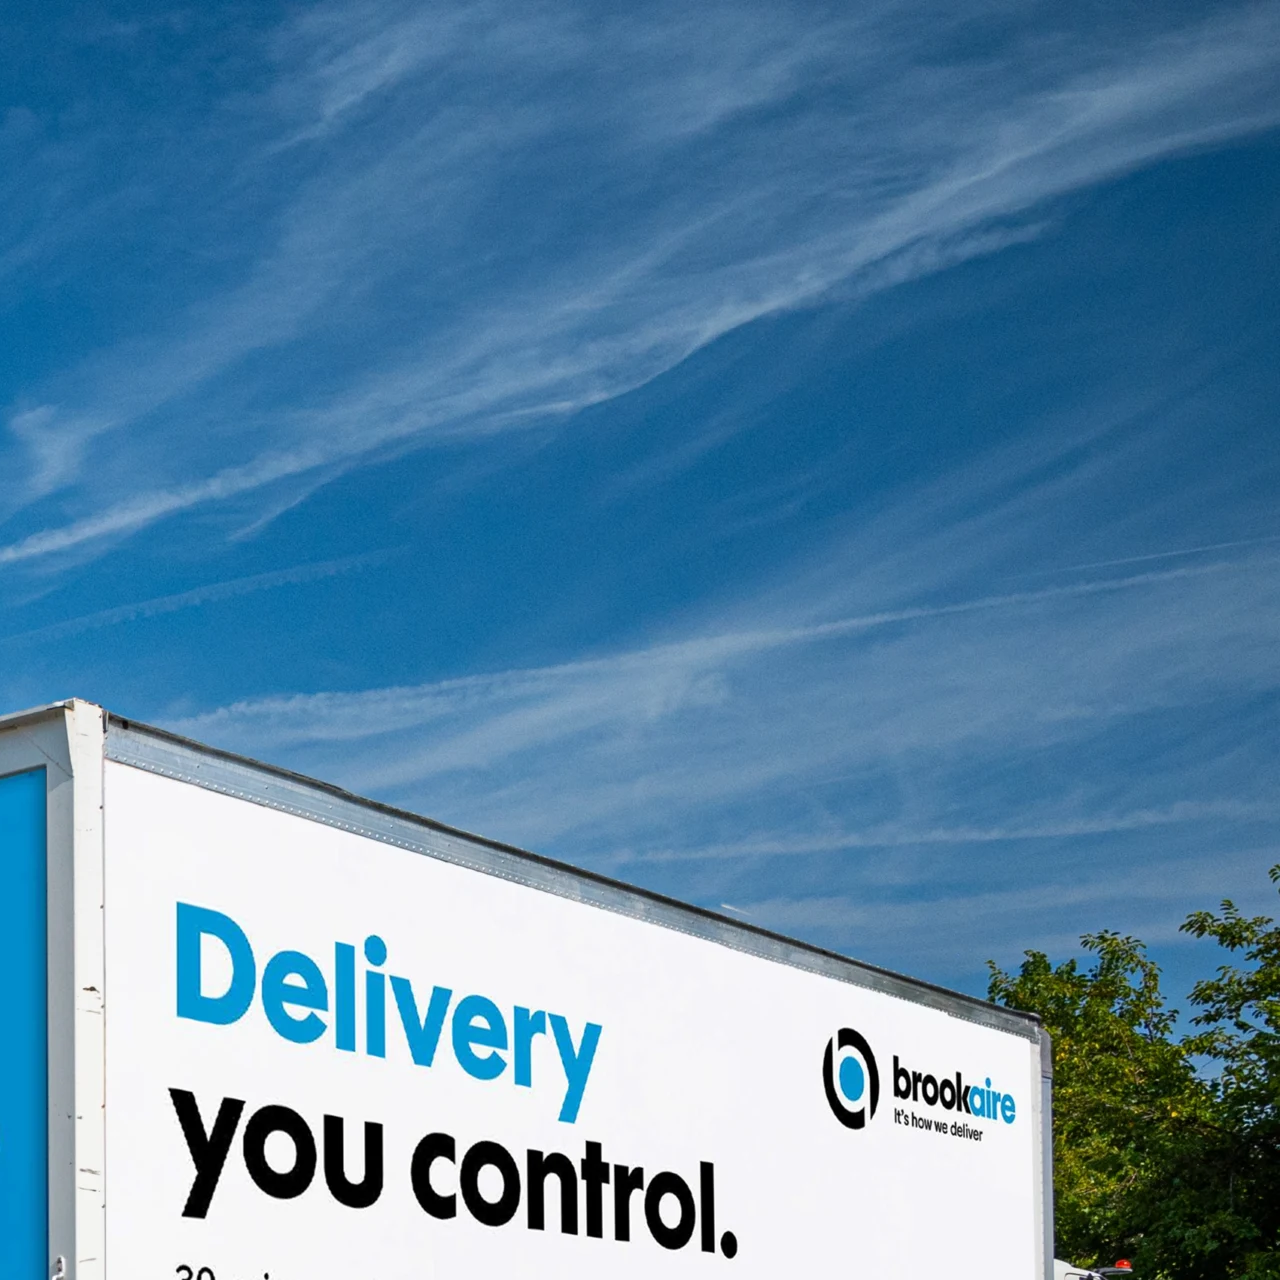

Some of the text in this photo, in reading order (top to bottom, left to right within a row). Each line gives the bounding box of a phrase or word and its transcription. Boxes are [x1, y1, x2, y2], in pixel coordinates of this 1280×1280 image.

[177, 902, 601, 1123] Delivery
[893, 1055, 1015, 1124] brookaire
[894, 1108, 983, 1142] It's how we deliver
[168, 1088, 738, 1259] you control.
